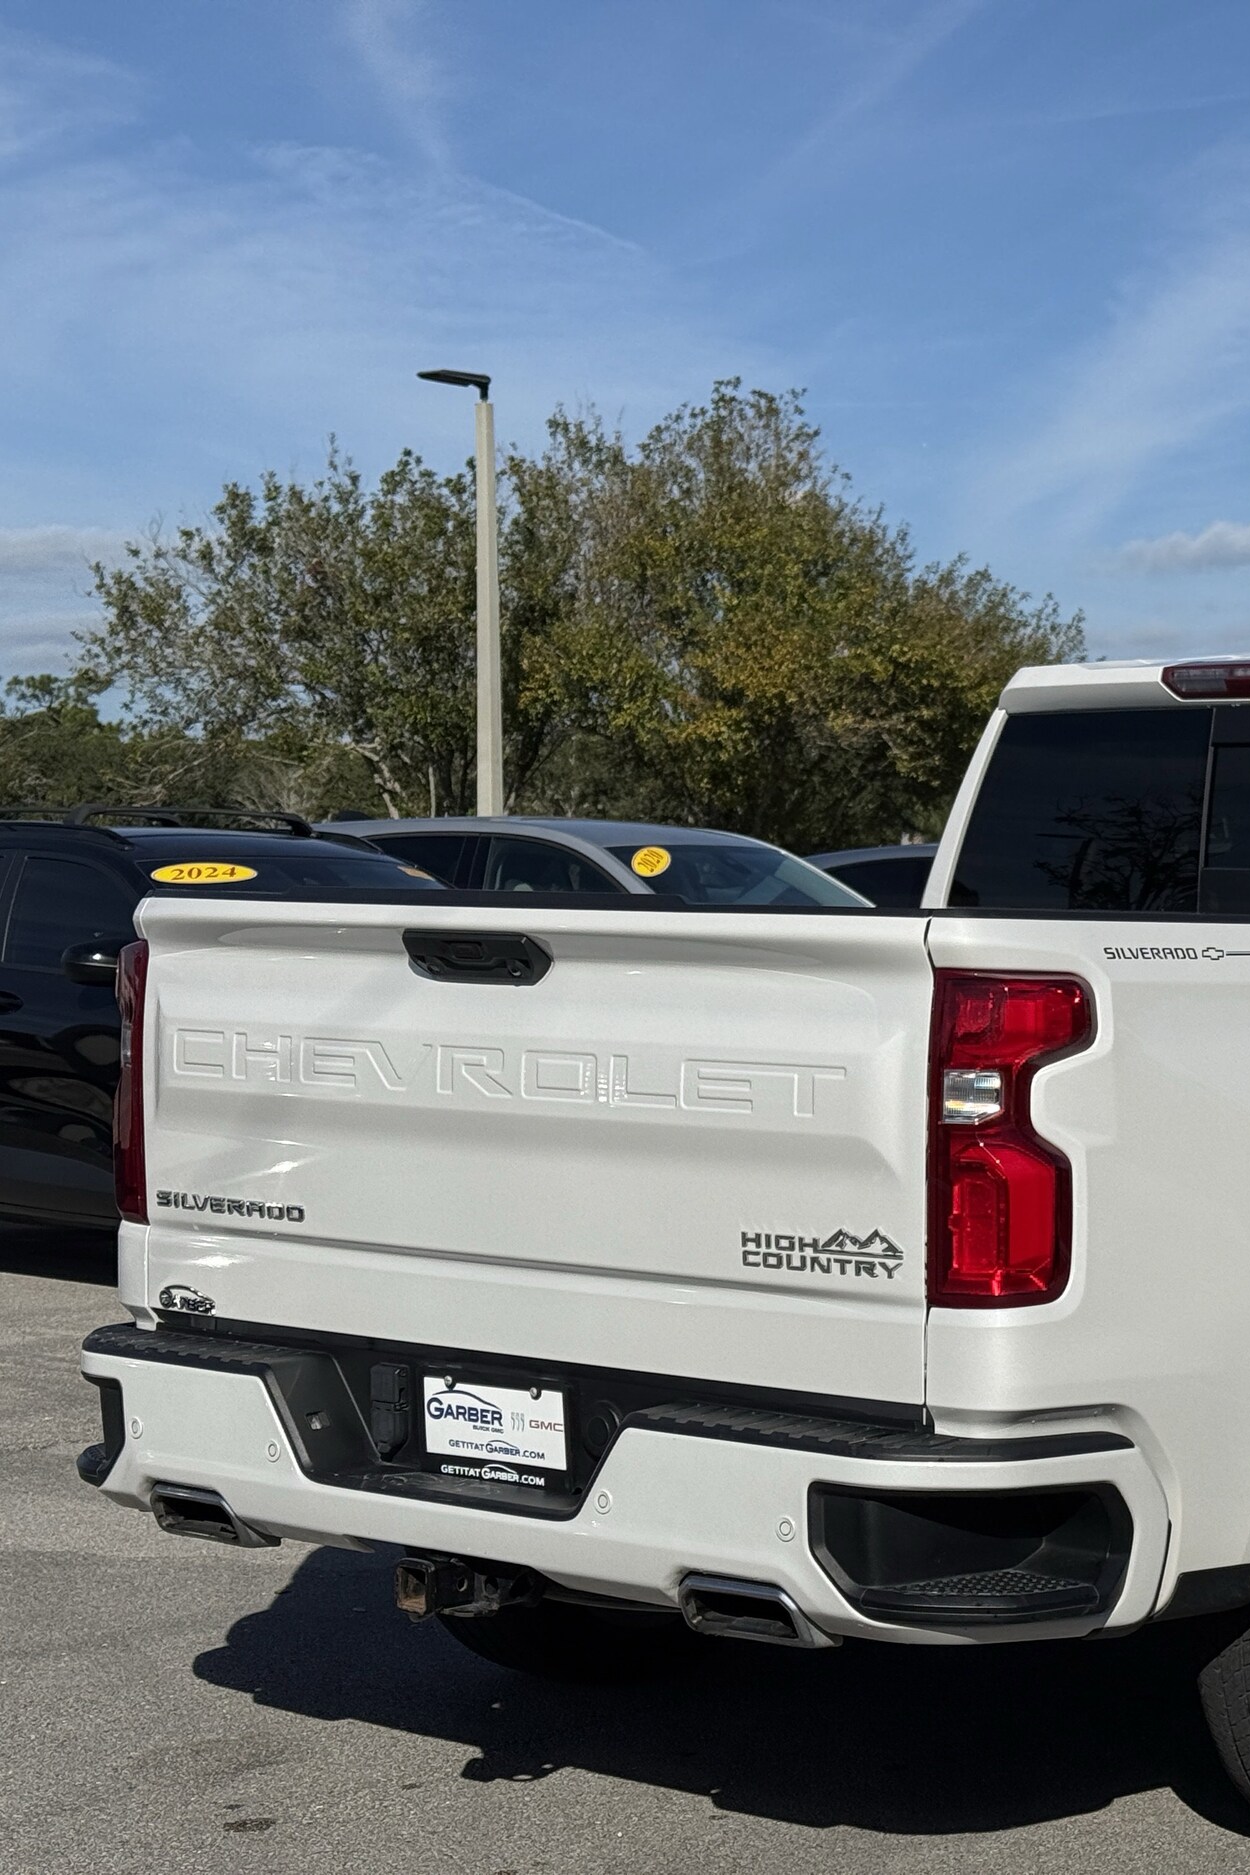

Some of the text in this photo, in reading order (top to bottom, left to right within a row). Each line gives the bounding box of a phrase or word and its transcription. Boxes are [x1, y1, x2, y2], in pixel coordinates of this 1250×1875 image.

[170, 866, 237, 881] 2024
[1103, 947, 1199, 960] SILVERADO
[172, 1027, 847, 1118] CHEVROLET
[156, 1190, 306, 1224] SILVERADO
[741, 1231, 821, 1254] HIGH
[742, 1250, 904, 1280] COUNTRY
[426, 1397, 504, 1427] GARBER
[529, 1419, 564, 1433] GMC
